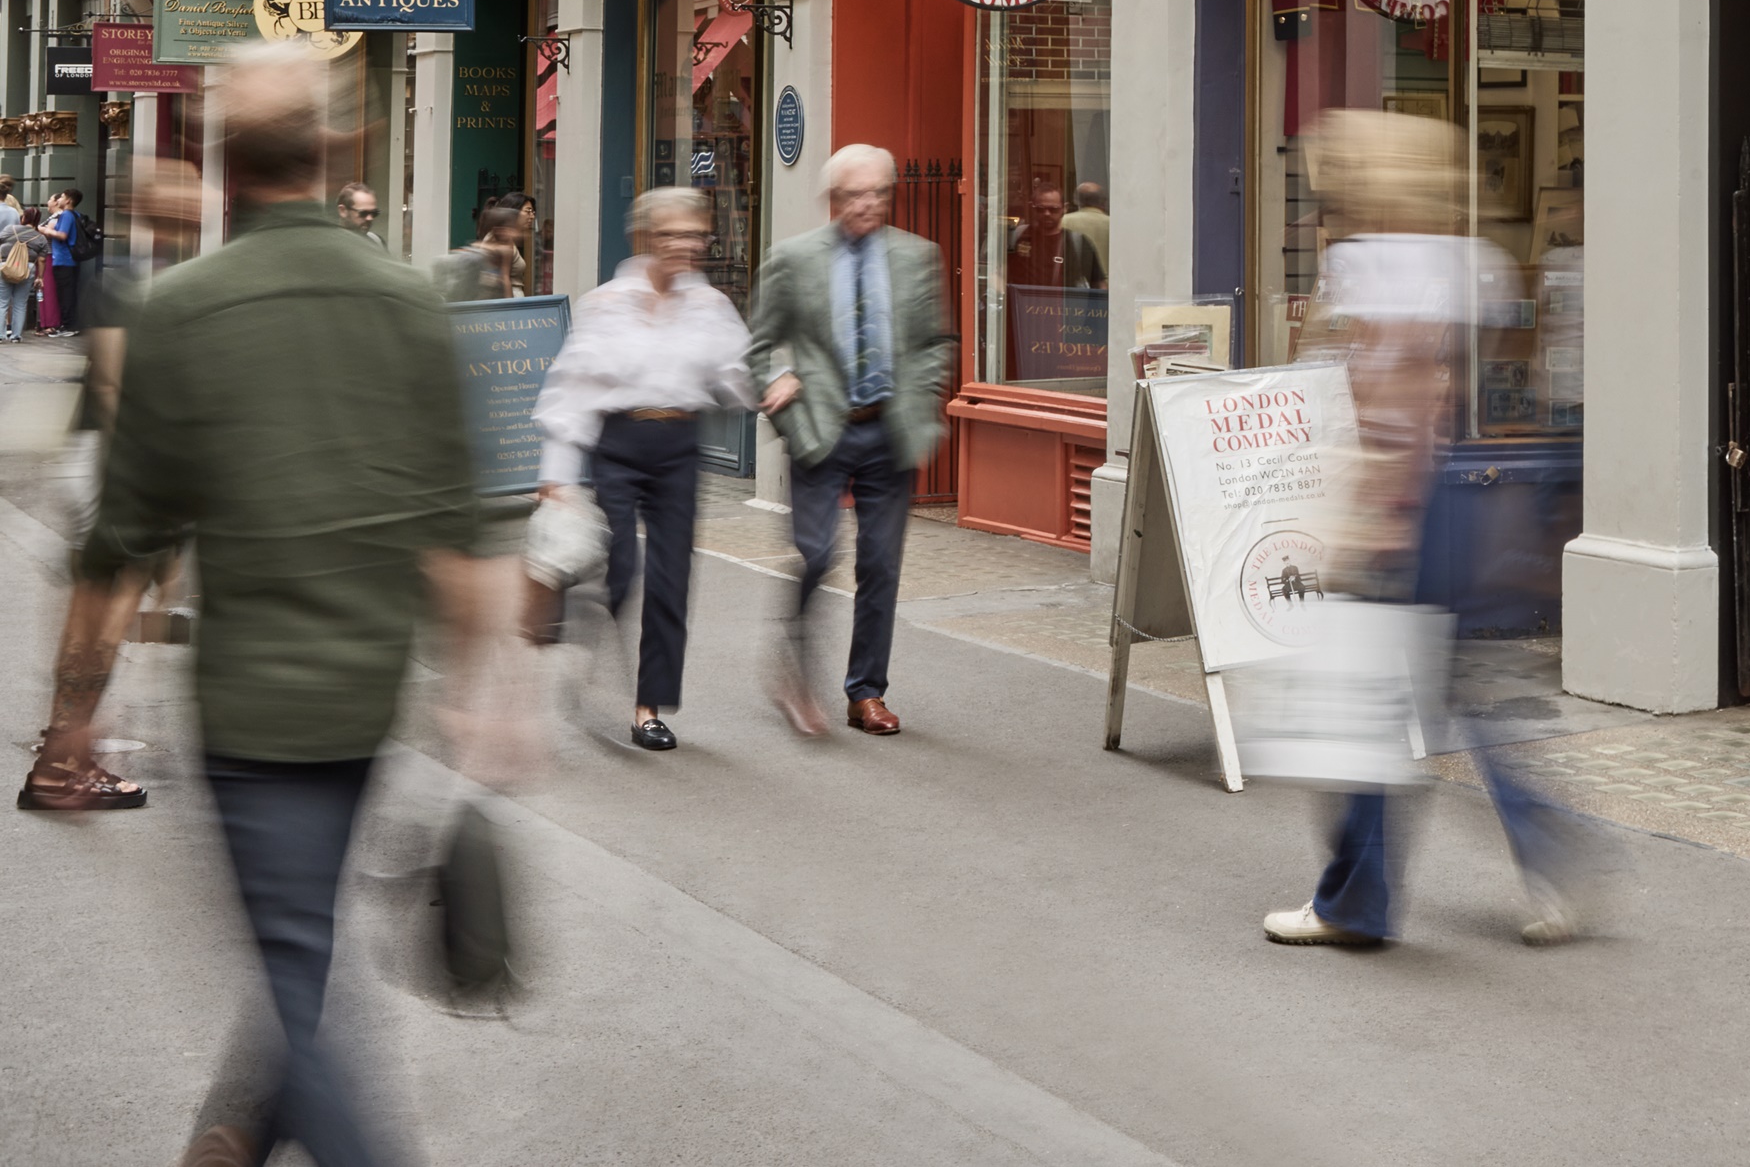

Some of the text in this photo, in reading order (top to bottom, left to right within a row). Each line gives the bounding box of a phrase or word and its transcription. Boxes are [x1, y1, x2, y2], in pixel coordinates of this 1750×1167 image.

[164, 0, 209, 14] Daniel
[178, 18, 249, 29] Fine Antique Silver
[102, 29, 153, 40] STOREY
[189, 28, 216, 37] Objects
[217, 28, 227, 37] of
[109, 48, 151, 57] ORIGINAL
[103, 57, 152, 65] ENGRAVING
[459, 66, 517, 79] BOOKS
[464, 84, 511, 96] MAPS
[480, 100, 491, 112] &
[457, 116, 516, 129] PRINTS
[456, 317, 558, 334] MARK SULLIVAN
[1205, 389, 1306, 414] LONDON
[1211, 408, 1311, 434] MEDAL
[1213, 427, 1312, 453] COMPANY
[1216, 452, 1319, 472] No. 13 Cecil Court
[1218, 464, 1321, 486] London WC2N 4AN
[1221, 478, 1322, 500] Tel: 020 7836 8877
[1224, 491, 1327, 510] shop@london-medals.co.uk
[1251, 547, 1272, 571] THE
